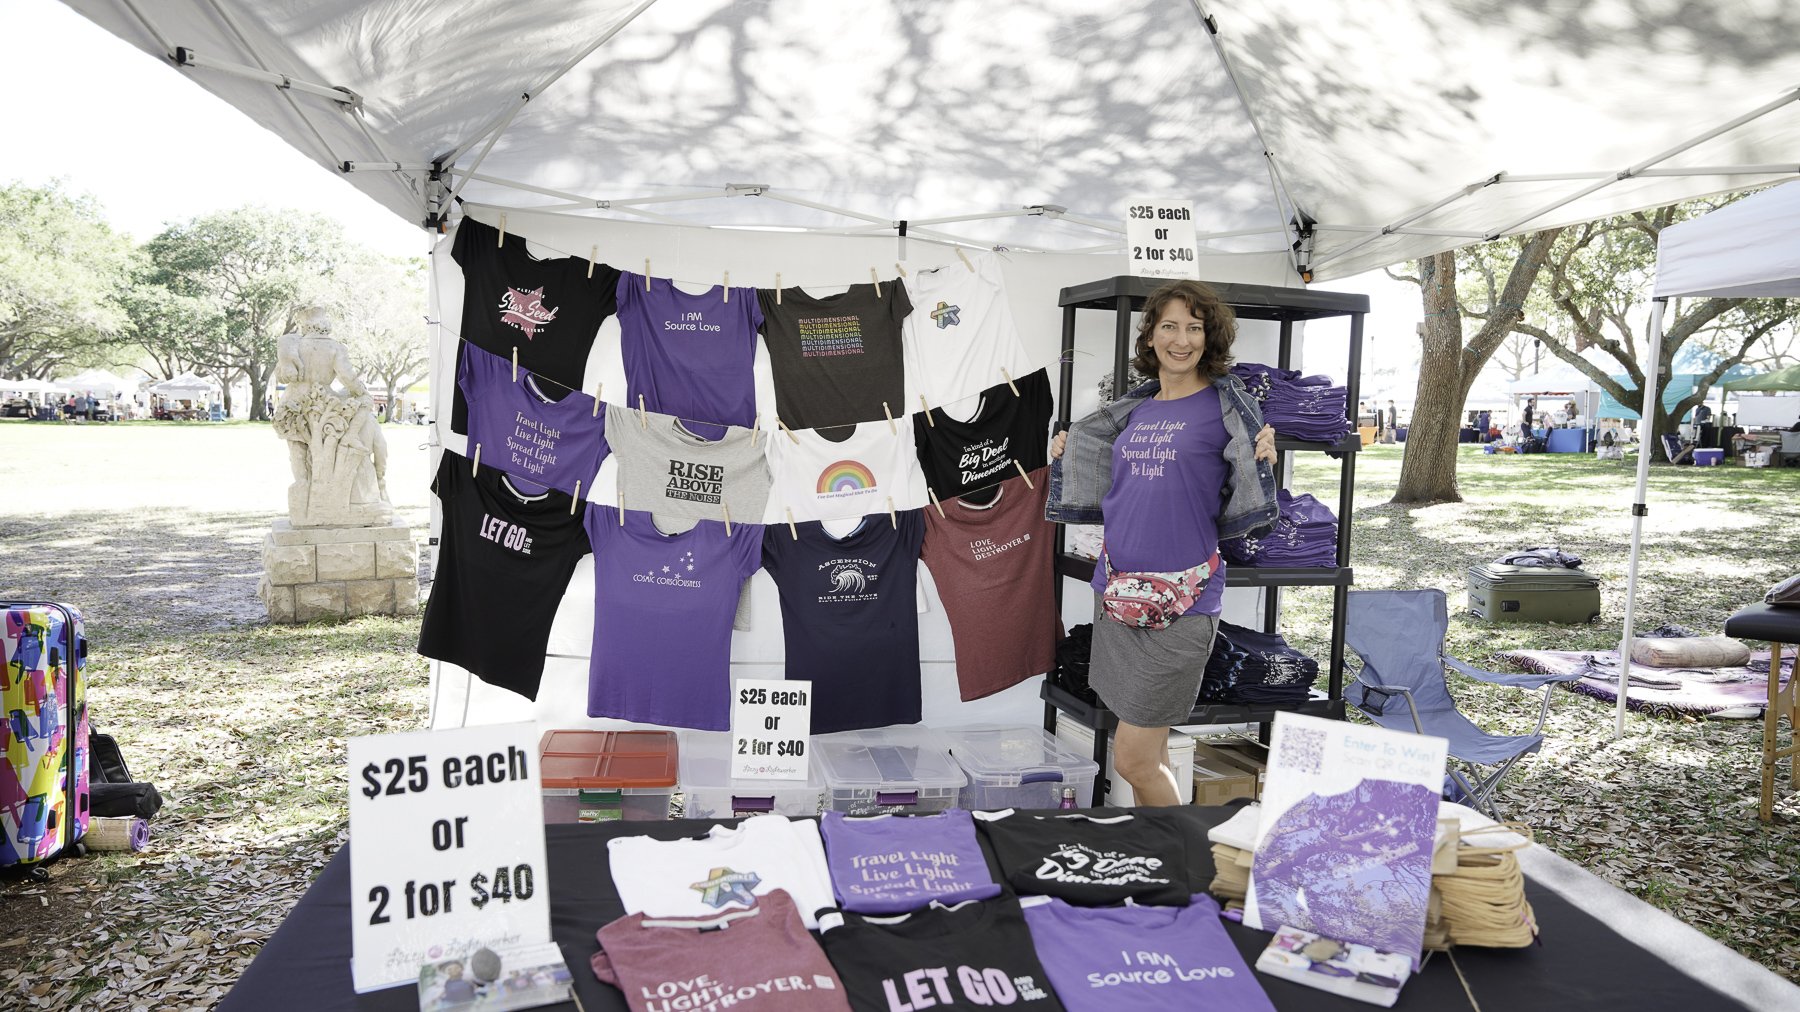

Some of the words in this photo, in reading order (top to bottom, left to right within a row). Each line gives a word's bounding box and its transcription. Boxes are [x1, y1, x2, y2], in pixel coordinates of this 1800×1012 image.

[1130, 206, 1154, 218] $25
[1158, 207, 1190, 220] each
[1155, 228, 1168, 240] or
[1134, 246, 1142, 260] 2
[1146, 247, 1164, 260] for
[1169, 248, 1194, 261] $40
[498, 291, 525, 313] Star
[526, 300, 559, 322] Seed
[682, 313, 684, 321] I
[687, 312, 702, 321] AM
[798, 316, 860, 324] MULTIDIMENSIONAL
[800, 321, 860, 330] MULTIDIMENSIONAL
[664, 320, 696, 330] Source
[699, 322, 720, 332] Love
[800, 326, 861, 334] MULTIDIMENSIONAL
[800, 332, 862, 340] MULTIDIMENSIONAL
[802, 337, 862, 346] MULTIDIMENSIONAL
[802, 342, 864, 352] MULTIDIMENSIONAL
[802, 348, 864, 358] MULTIDIMENSIONAL
[516, 410, 538, 430] Travel
[540, 422, 560, 440] Light
[1134, 421, 1160, 430] Travel
[1160, 420, 1187, 432] Light
[515, 426, 532, 440] Live
[532, 433, 556, 450] Light
[1130, 432, 1148, 443] Live
[1150, 432, 1174, 446] Light
[506, 436, 533, 456] Spread
[534, 448, 557, 465] Light
[958, 453, 980, 469] Big
[982, 437, 1008, 461] Deal
[1122, 446, 1150, 461] Spread
[1152, 446, 1178, 464] Light
[512, 452, 522, 465] Be
[523, 457, 544, 474] Light
[668, 460, 724, 482] RISE
[962, 458, 1012, 484] Dimension
[1131, 462, 1140, 476] Be
[1142, 462, 1164, 480] Light
[667, 476, 722, 494] ABOVE
[667, 490, 688, 500] THE
[690, 492, 720, 503] NOISE
[480, 513, 508, 544] LET
[504, 524, 527, 551] GO
[970, 538, 994, 548] LOVE.
[972, 544, 1000, 554] LIGHT.
[975, 538, 1024, 560] DESTROYER.
[818, 558, 876, 570] ASCENSION
[633, 574, 655, 584] COSMIC
[740, 688, 766, 704] $25
[772, 690, 806, 706] each
[764, 716, 780, 730] or
[738, 738, 747, 754] 2
[752, 739, 773, 755] for
[778, 740, 804, 756] $40
[1344, 736, 1377, 752] Enter
[1384, 742, 1397, 756] To
[1401, 745, 1436, 763] Win!
[362, 754, 428, 800] $25
[442, 746, 528, 788] each
[432, 816, 469, 852] or
[850, 852, 908, 868] Travel
[910, 851, 960, 866] Light
[862, 868, 902, 882] Live
[904, 862, 956, 880] Light
[368, 885, 391, 926] 2
[404, 879, 456, 920] for
[470, 863, 534, 910] $40
[849, 878, 920, 895] Spread
[923, 878, 974, 892] Light
[1122, 950, 1132, 966] I
[1136, 951, 1178, 967] AM
[1086, 970, 1172, 988] Source
[1175, 966, 1235, 981] Love
[641, 974, 718, 999] LOVE.
[882, 967, 954, 1012] LET
[956, 965, 1018, 1006] GO
[646, 984, 734, 1012] LIGHT.
